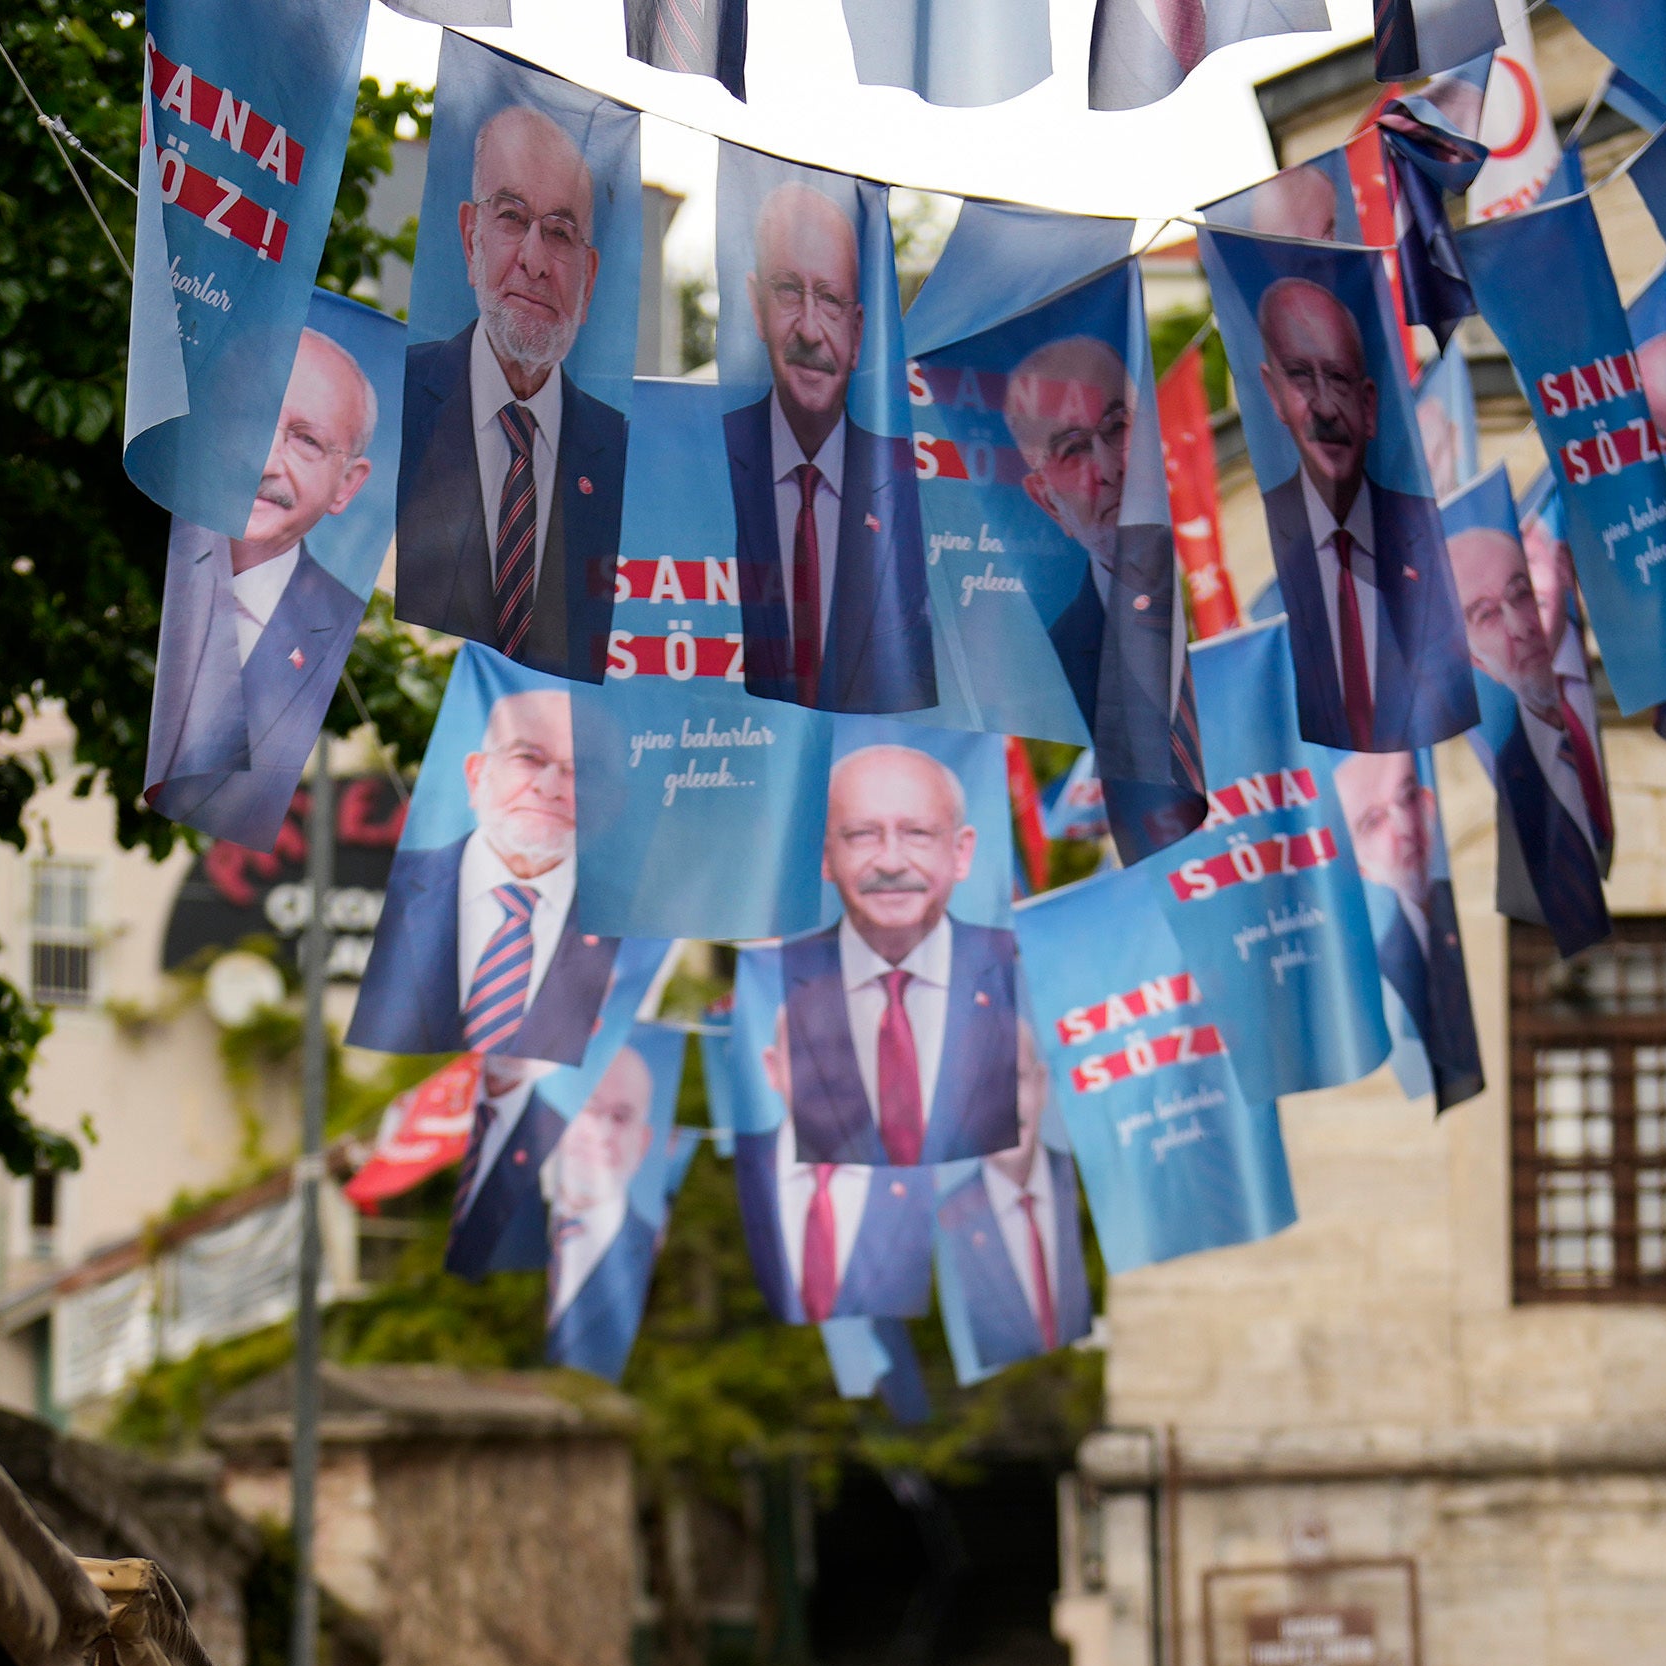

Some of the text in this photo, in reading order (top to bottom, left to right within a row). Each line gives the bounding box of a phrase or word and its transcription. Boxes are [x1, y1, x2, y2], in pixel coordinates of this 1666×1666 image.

[157, 134, 278, 261] ÖZ!
[168, 256, 233, 313] harlar
[1566, 417, 1661, 485] SÖZ
[927, 531, 971, 566] yine
[614, 555, 741, 606] SAN
[605, 620, 745, 682] SÖZ
[628, 717, 776, 768] yine baharlar
[1202, 768, 1311, 831] ANA
[1179, 826, 1330, 900] SÖZ!
